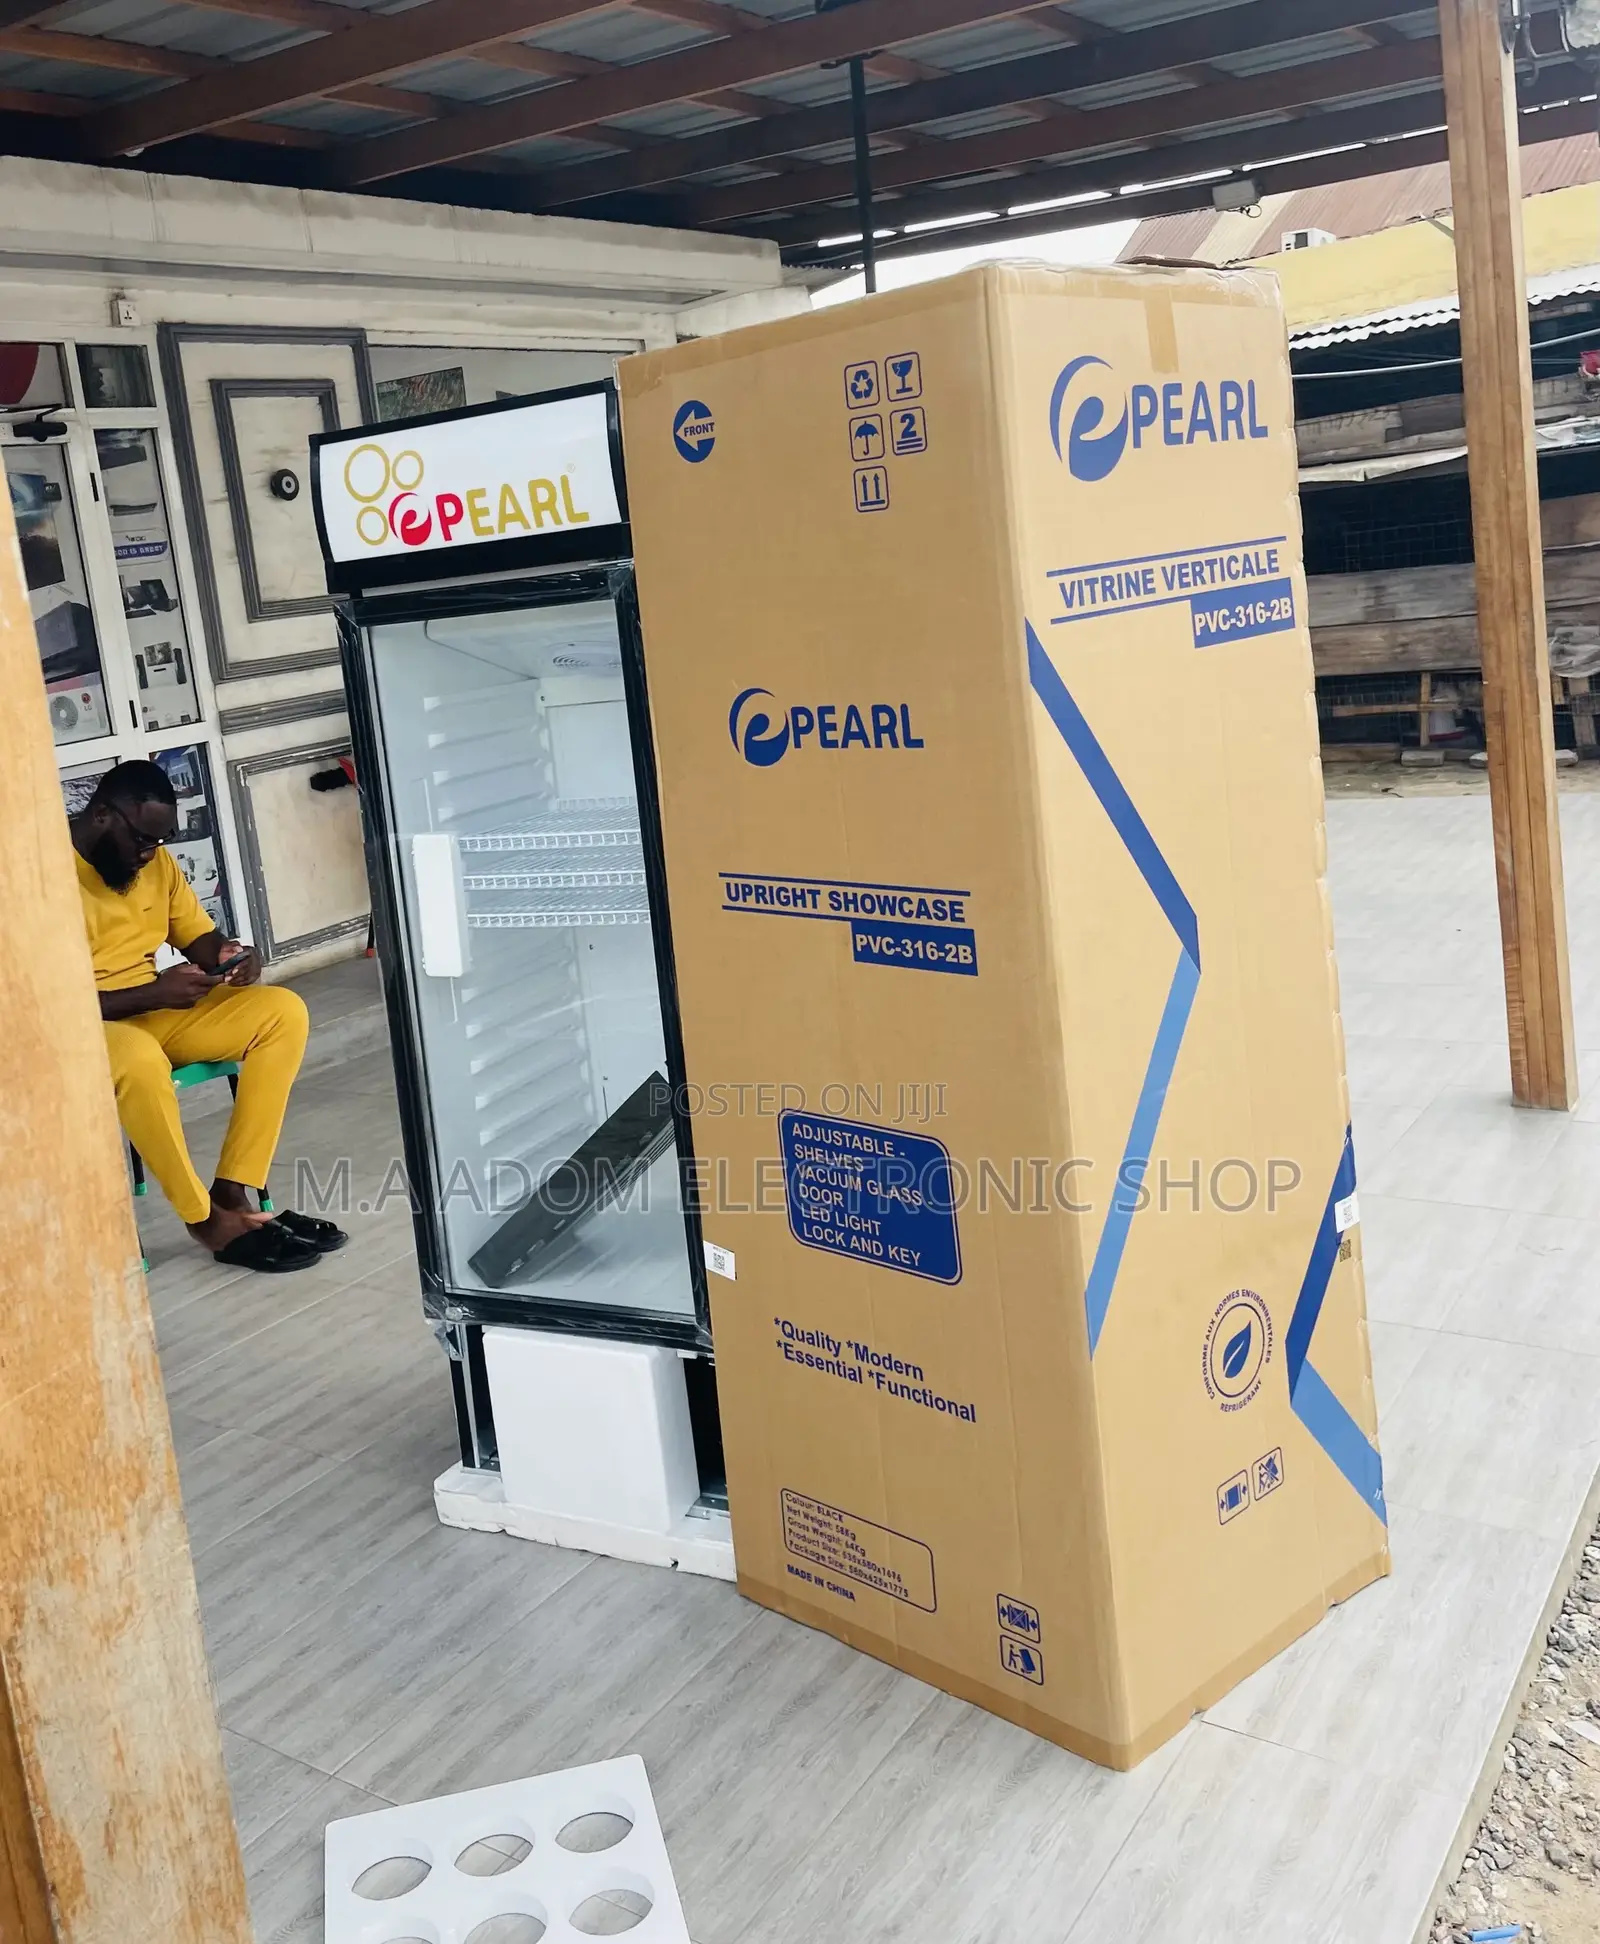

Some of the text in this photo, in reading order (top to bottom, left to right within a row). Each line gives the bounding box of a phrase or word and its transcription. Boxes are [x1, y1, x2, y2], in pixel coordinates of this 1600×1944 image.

[684, 422, 715, 438] FRONT
[1058, 548, 1280, 609] VITRINE VERTICALE
[1193, 596, 1293, 637] PVC-316-2B
[726, 882, 965, 923] UPRIGHT SHOWCASE
[855, 933, 973, 965] PVC-316-2B
[792, 1122, 895, 1158] ADJUSTABLE
[794, 1143, 864, 1172] SHELVES
[796, 1163, 862, 1192] VACUUM
[866, 1179, 923, 1206] GLASS
[799, 1183, 844, 1207] DOOR
[801, 1203, 882, 1236] LED LIGHT
[803, 1222, 921, 1266] LOCK AND KEY
[1214, 1289, 1240, 1318] NORMES
[1205, 1318, 1216, 1341] AUX
[1202, 1343, 1216, 1400] CONFORME
[786, 1505, 801, 1516] Net
[788, 1516, 810, 1532] Gross
[817, 1505, 843, 1523] BLACK
[788, 1528, 820, 1549] Product
[789, 1539, 826, 1561] Package
[787, 1563, 856, 1602] MADE IN CHINA
